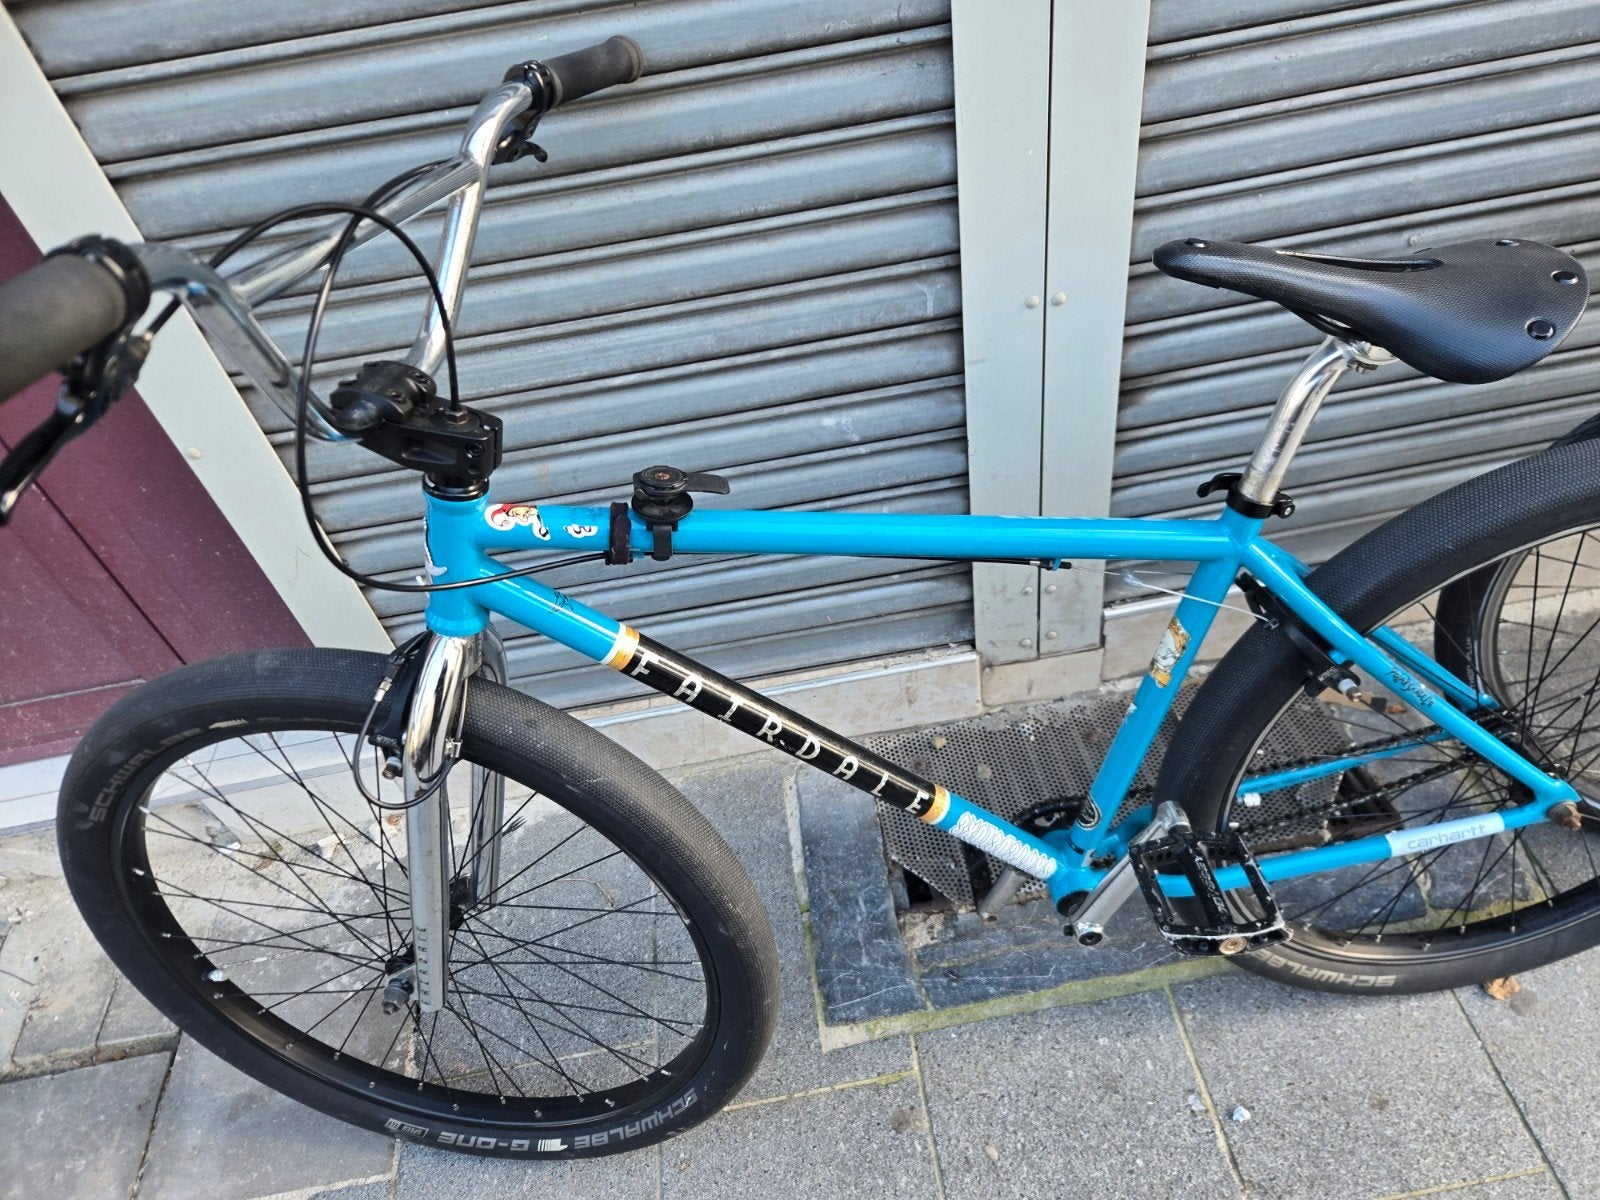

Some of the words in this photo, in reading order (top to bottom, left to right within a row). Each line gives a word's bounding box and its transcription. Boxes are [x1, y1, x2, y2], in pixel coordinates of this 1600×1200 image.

[630, 650, 930, 815] FAIRDALE
[1407, 825, 1486, 850] carhartt
[1252, 949, 1397, 988] SCHWALBE
[574, 1087, 698, 1149] SCHWALBE
[437, 1131, 529, 1151] G-ONE
